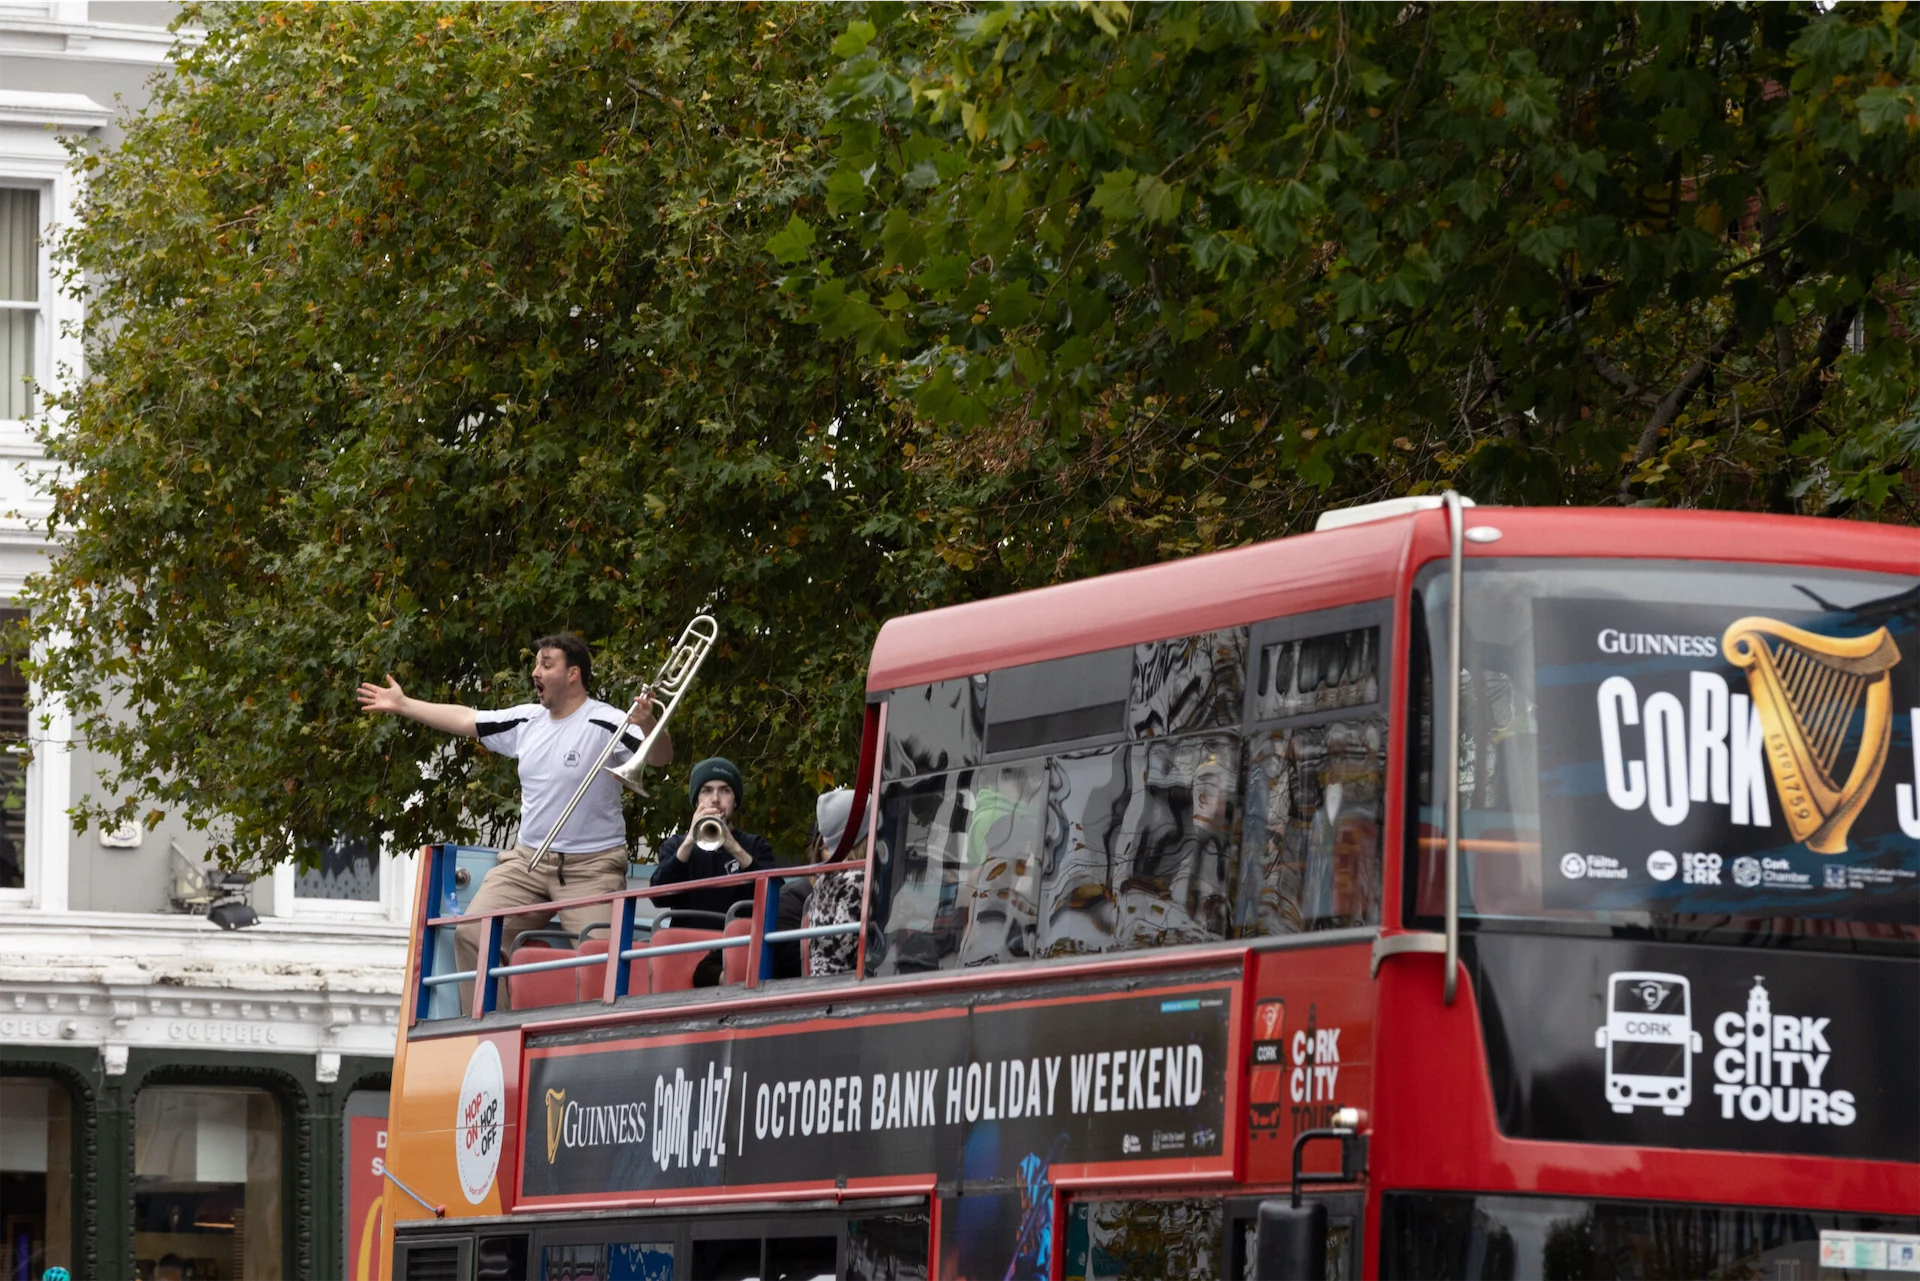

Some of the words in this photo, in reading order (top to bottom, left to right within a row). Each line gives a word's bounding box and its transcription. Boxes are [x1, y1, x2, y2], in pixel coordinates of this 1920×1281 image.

[1597, 628, 1718, 657] GUINNESS
[1597, 670, 1772, 828] CORK
[168, 1021, 278, 1044] COFFEES
[1292, 1027, 1341, 1066] CORK
[1625, 1020, 1673, 1037] CORK
[1714, 1011, 1832, 1053] CORK
[1290, 1065, 1340, 1103] CITY
[1714, 1048, 1831, 1088] CITY
[465, 1092, 482, 1128] HOP
[480, 1098, 498, 1134] HOP
[563, 1100, 647, 1149] GUINNESS
[652, 1067, 694, 1172] CORK
[692, 1061, 732, 1168] JAZZ
[755, 1075, 862, 1140] OCTOBER
[870, 1068, 939, 1131] BANK
[945, 1056, 1061, 1125] HOLIDAY
[1071, 1044, 1204, 1114] WEEKEND
[1713, 1083, 1857, 1126] TOURS
[466, 1120, 478, 1150] ON
[481, 1122, 497, 1156] OFF
